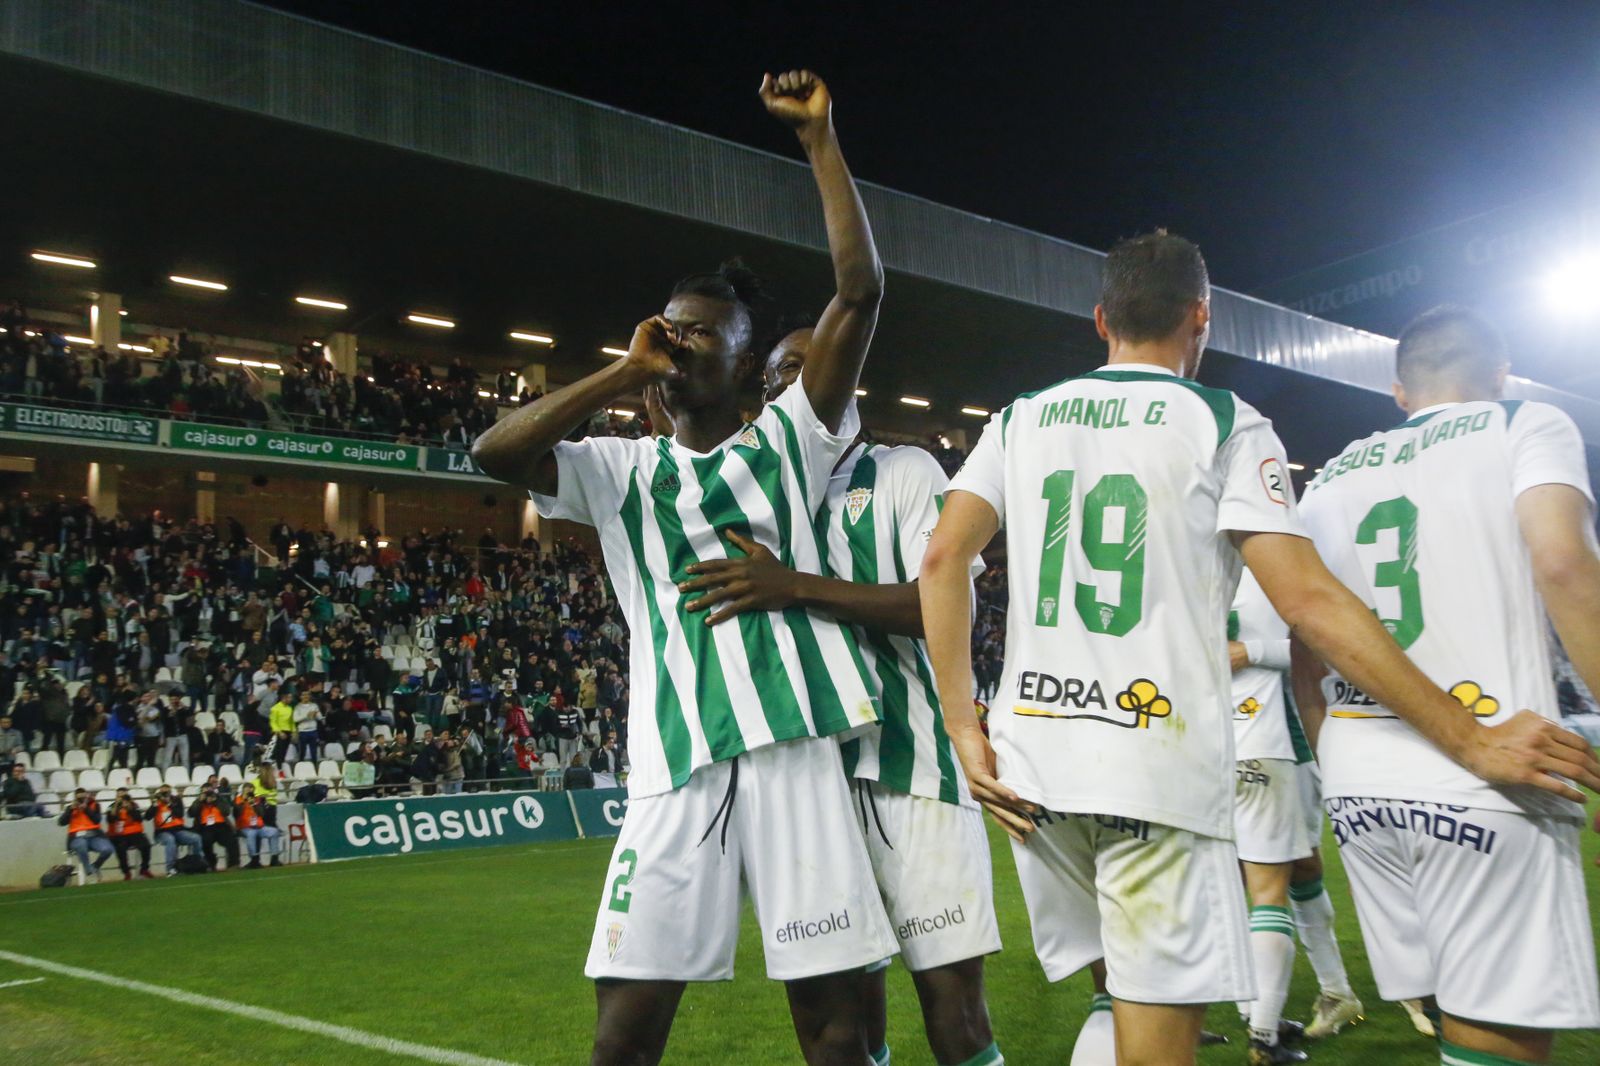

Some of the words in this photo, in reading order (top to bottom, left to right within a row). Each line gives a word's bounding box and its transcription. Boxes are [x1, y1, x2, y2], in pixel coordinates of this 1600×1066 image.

[1038, 397, 1130, 429] IMANOL
[1143, 400, 1167, 426] G.
[184, 429, 243, 447] cajasur
[267, 437, 320, 454] cajasur
[343, 445, 395, 461] cajasur
[1035, 469, 1149, 638] 19
[1355, 495, 1425, 651] 3
[1017, 670, 1108, 710] EDRA
[344, 801, 509, 853] cajasur
[1345, 807, 1497, 854] HYUNDAI
[608, 848, 638, 913] 2
[775, 909, 851, 945] efficold
[898, 904, 966, 940] efficold
